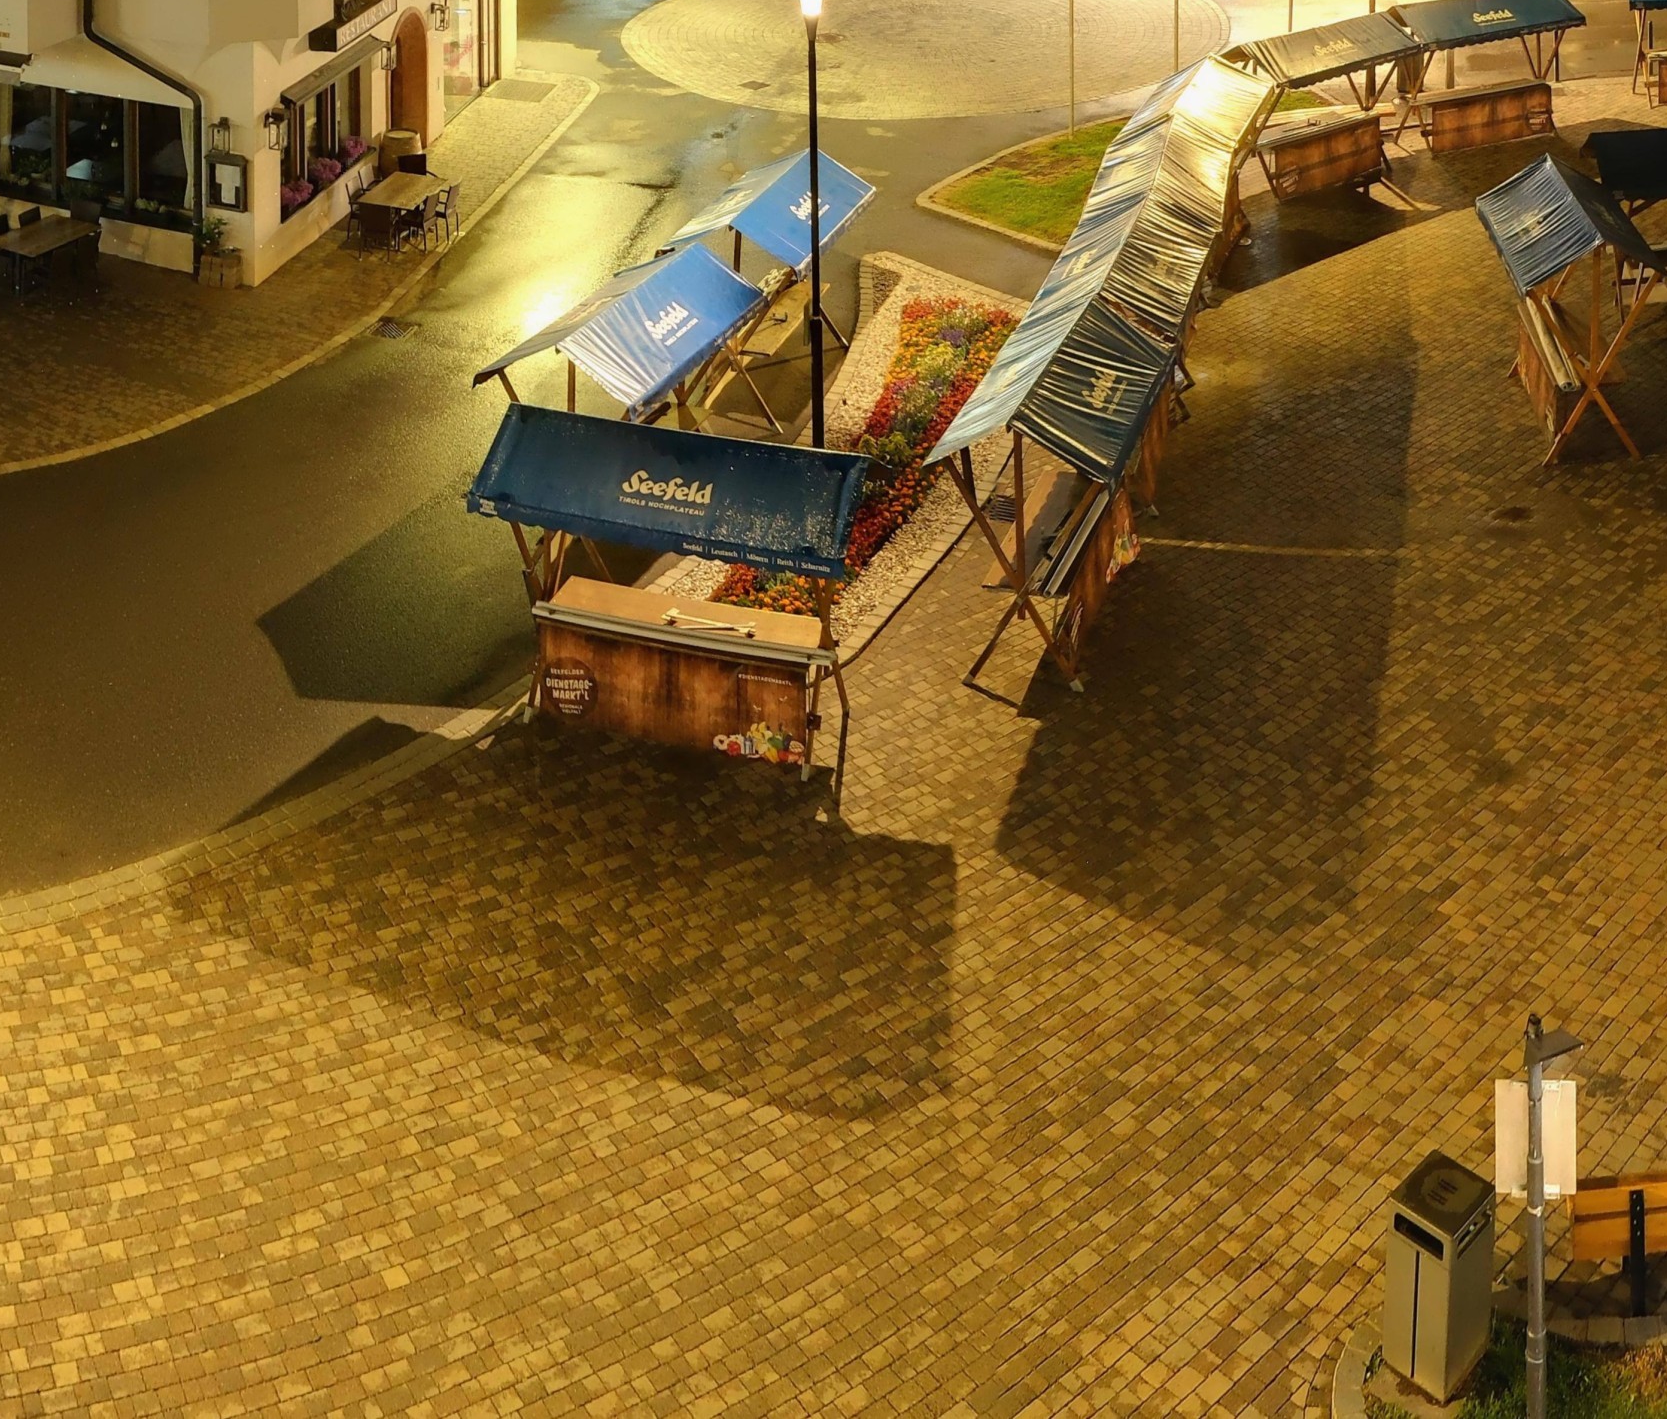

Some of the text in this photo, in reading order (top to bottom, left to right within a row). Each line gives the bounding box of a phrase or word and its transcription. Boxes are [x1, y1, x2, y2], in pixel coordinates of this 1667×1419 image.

[1472, 9, 1513, 23] Seefeld
[1313, 39, 1353, 57] Seefeld
[644, 301, 690, 340] Seefeld
[1081, 370, 1117, 409] Seefeld
[621, 469, 713, 505] Seefeld
[619, 495, 705, 517] TIROLS HOCHPLATEAU
[682, 542, 703, 553] Seefeld
[711, 547, 738, 559] Leutasch
[776, 556, 794, 568] Reith
[800, 561, 831, 573] Scharnitz
[550, 667, 585, 675] SEEFELDER
[546, 677, 593, 691] DIENSTAGS-
